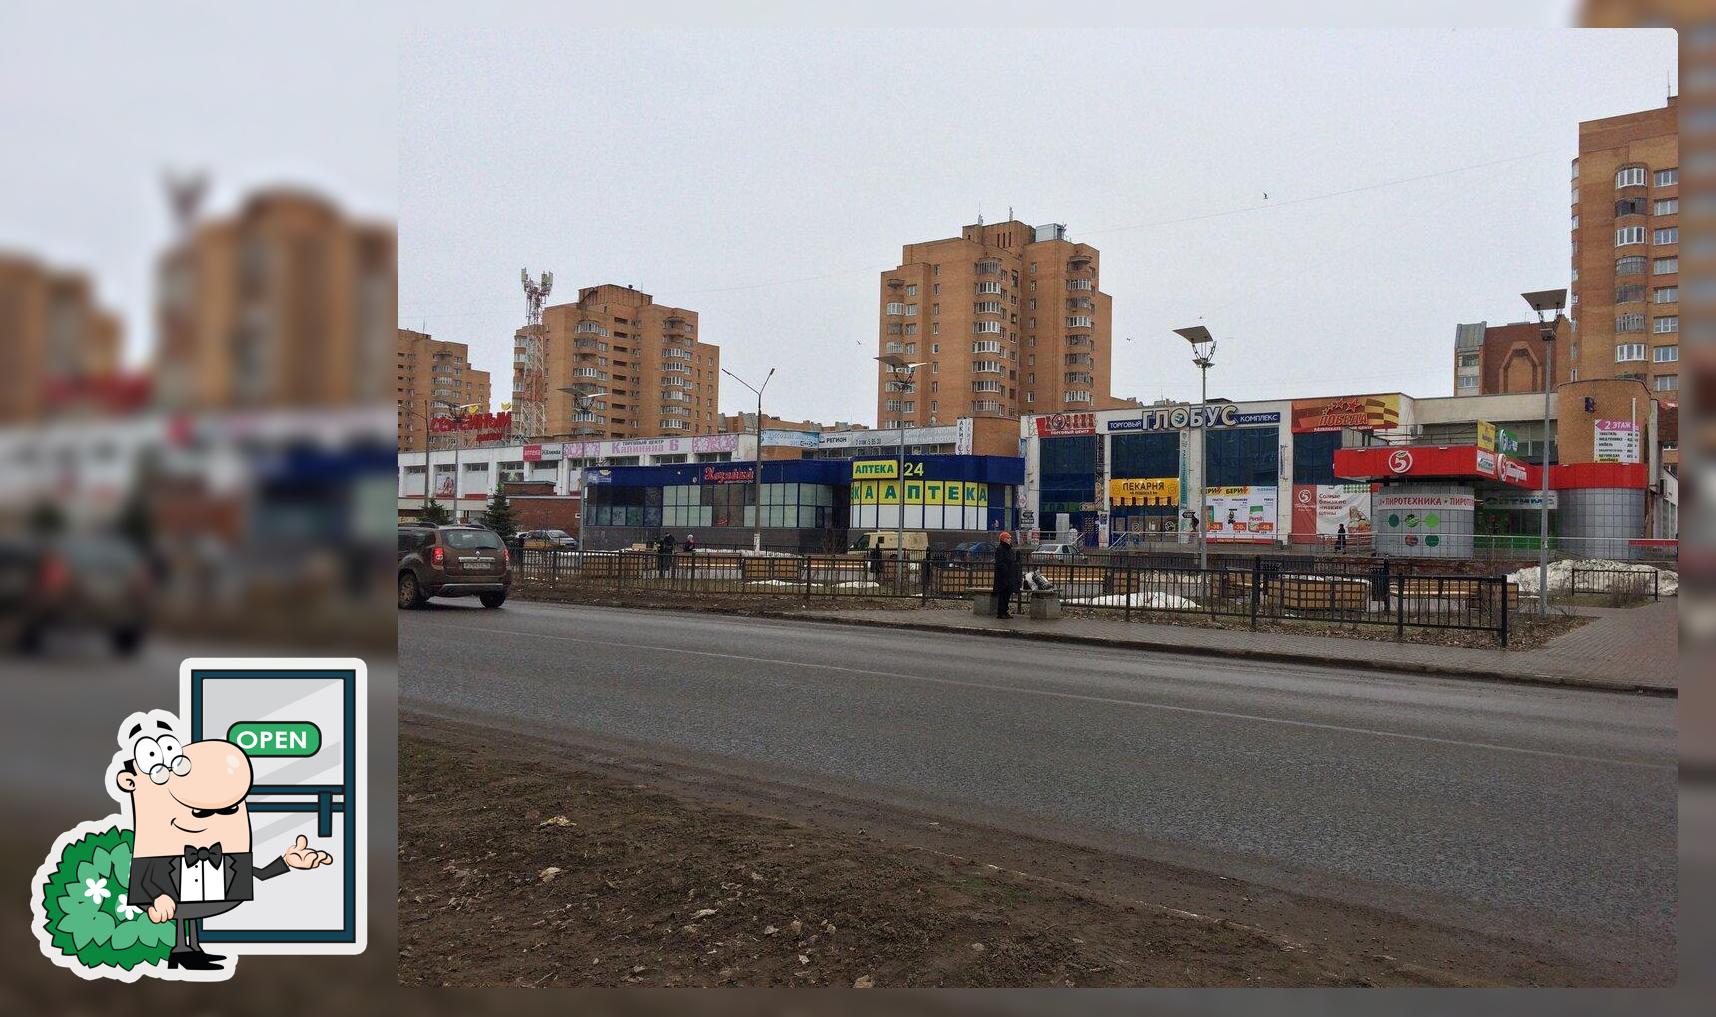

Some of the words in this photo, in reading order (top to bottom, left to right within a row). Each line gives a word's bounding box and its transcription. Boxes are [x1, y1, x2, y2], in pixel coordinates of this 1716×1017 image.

[1142, 405, 1238, 431] ГЛОБУС
[1240, 414, 1278, 423] КОМПЛЕКС
[1604, 421, 1611, 430] 2
[855, 464, 894, 474] АПТЕКА
[903, 462, 924, 477] 24
[1123, 482, 1165, 491] ПЕКАРНЯ
[884, 485, 987, 501] АПТЕКА
[1385, 496, 1442, 506] ПИРОТЕХНИКА
